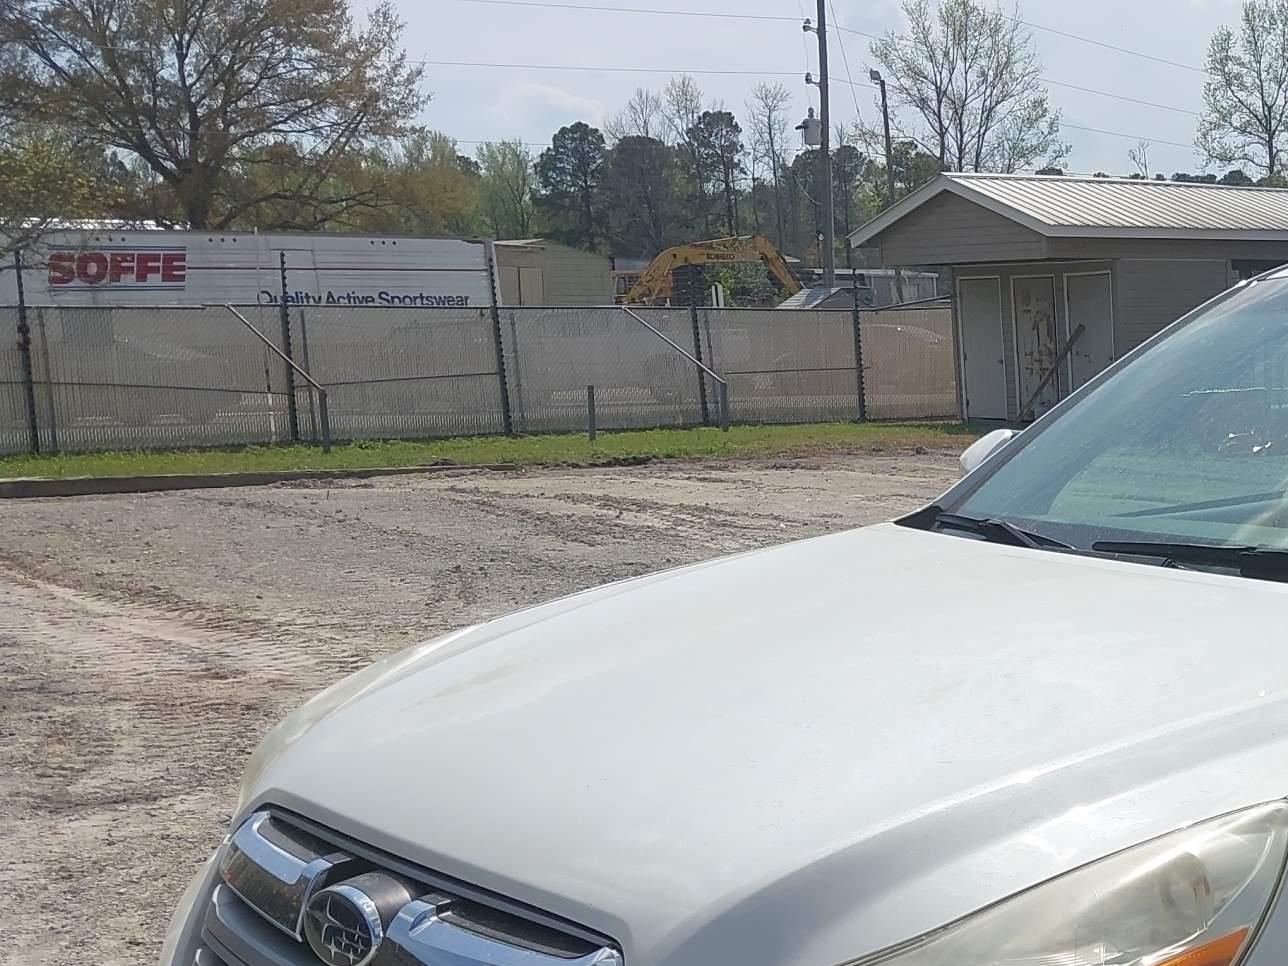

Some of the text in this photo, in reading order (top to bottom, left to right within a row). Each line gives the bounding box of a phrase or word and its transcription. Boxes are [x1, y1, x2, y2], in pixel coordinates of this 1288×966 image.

[48, 252, 187, 285] SOFFE
[326, 291, 376, 304] Active
[377, 291, 470, 307] Sportswear
